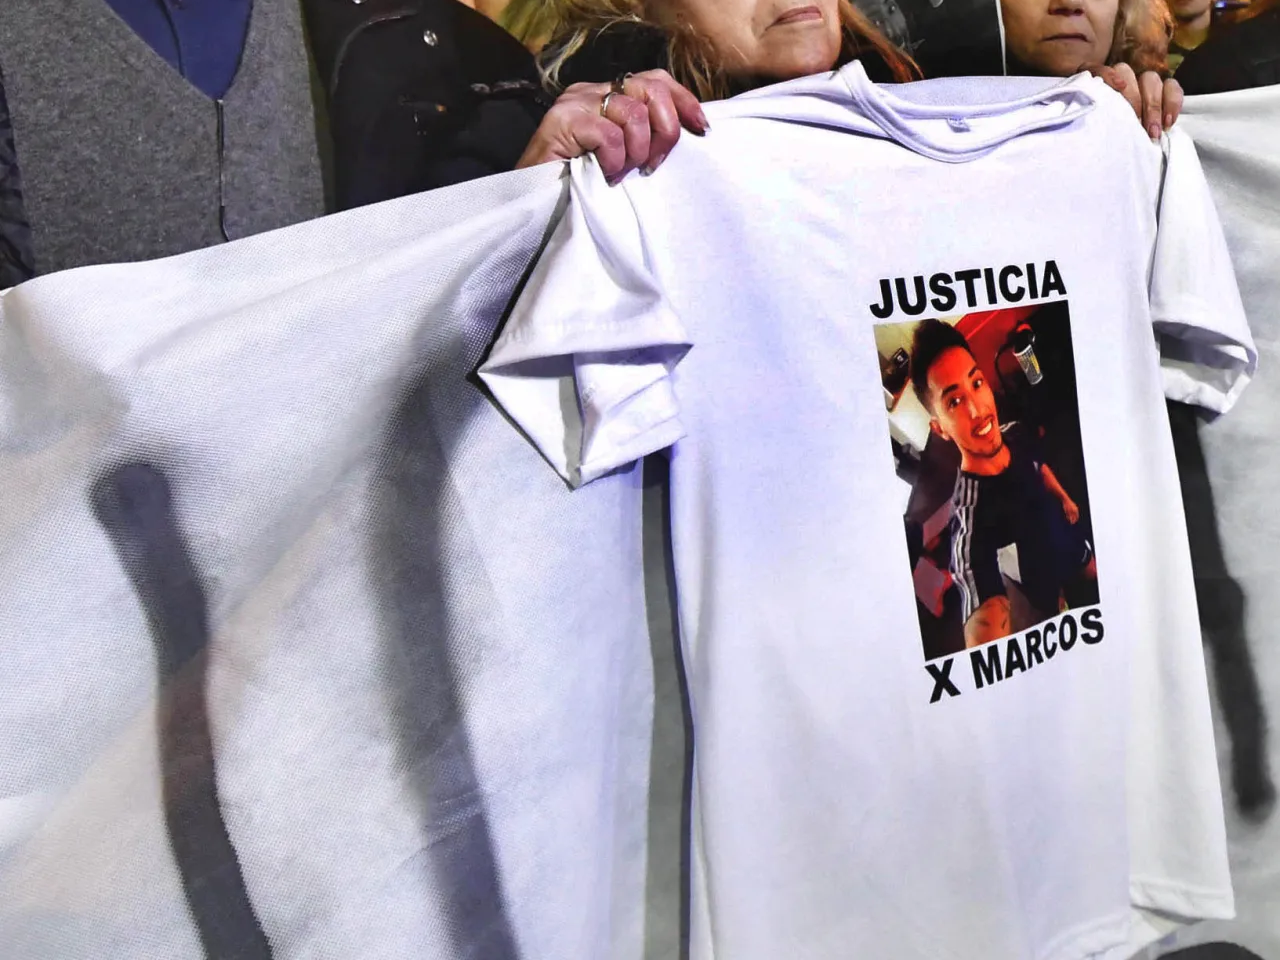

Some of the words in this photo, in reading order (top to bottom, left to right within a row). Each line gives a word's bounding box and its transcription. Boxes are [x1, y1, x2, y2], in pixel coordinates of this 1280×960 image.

[869, 259, 1067, 320] JUSTICIA
[924, 657, 962, 705] X
[970, 607, 1106, 690] MARCOS
